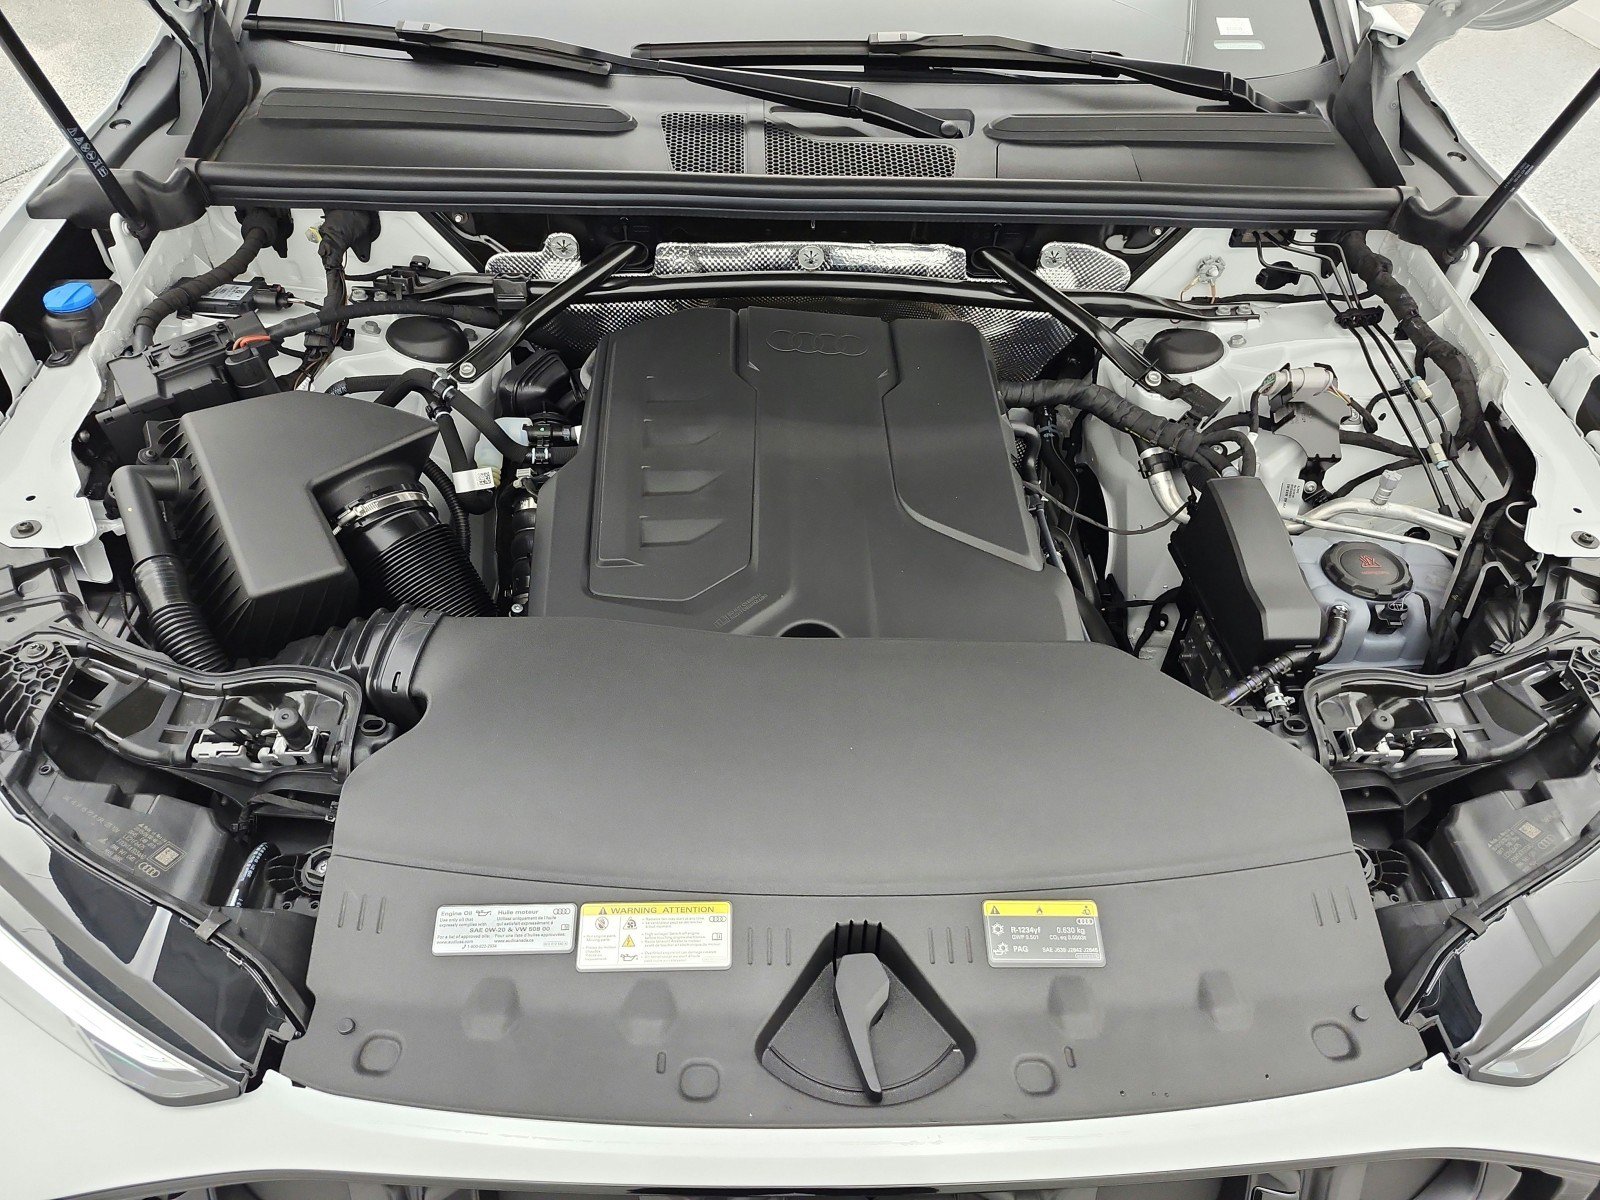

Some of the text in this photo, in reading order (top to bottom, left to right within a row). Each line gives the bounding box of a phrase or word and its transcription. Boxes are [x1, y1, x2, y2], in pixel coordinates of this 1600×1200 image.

[610, 906, 715, 914] WARNING ATTENTION
[1010, 926, 1040, 935] R-1234yf
[1076, 926, 1086, 935] kg
[1013, 945, 1029, 953] PAG
